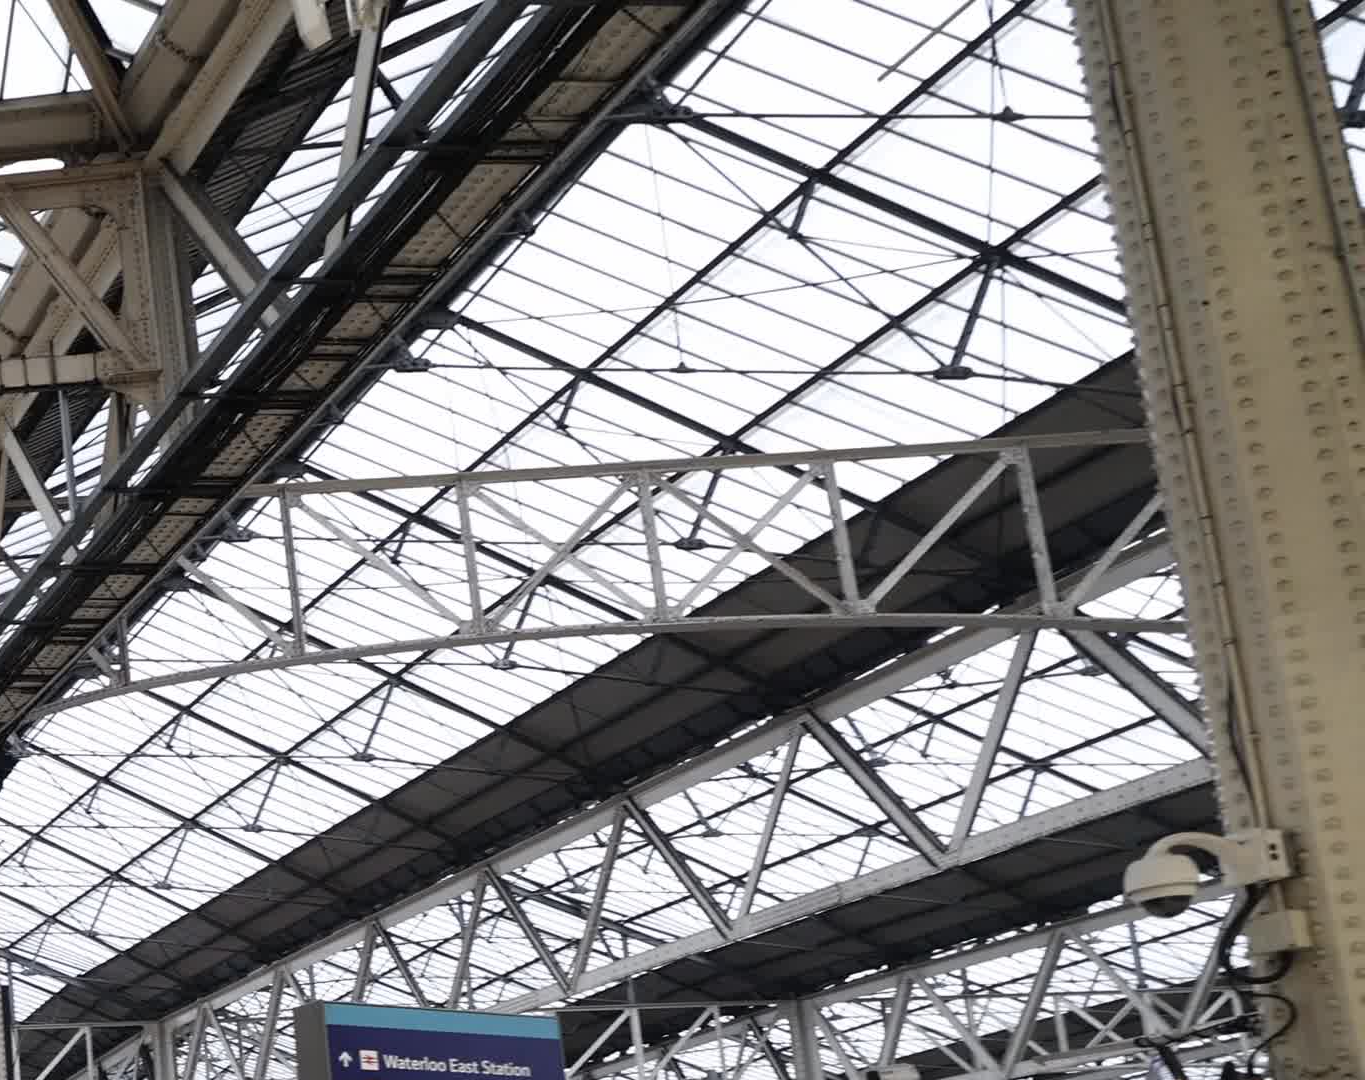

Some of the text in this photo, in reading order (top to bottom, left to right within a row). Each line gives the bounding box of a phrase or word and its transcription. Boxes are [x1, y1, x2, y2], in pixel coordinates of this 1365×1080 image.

[383, 1054, 532, 1077] Waterloo East Station
